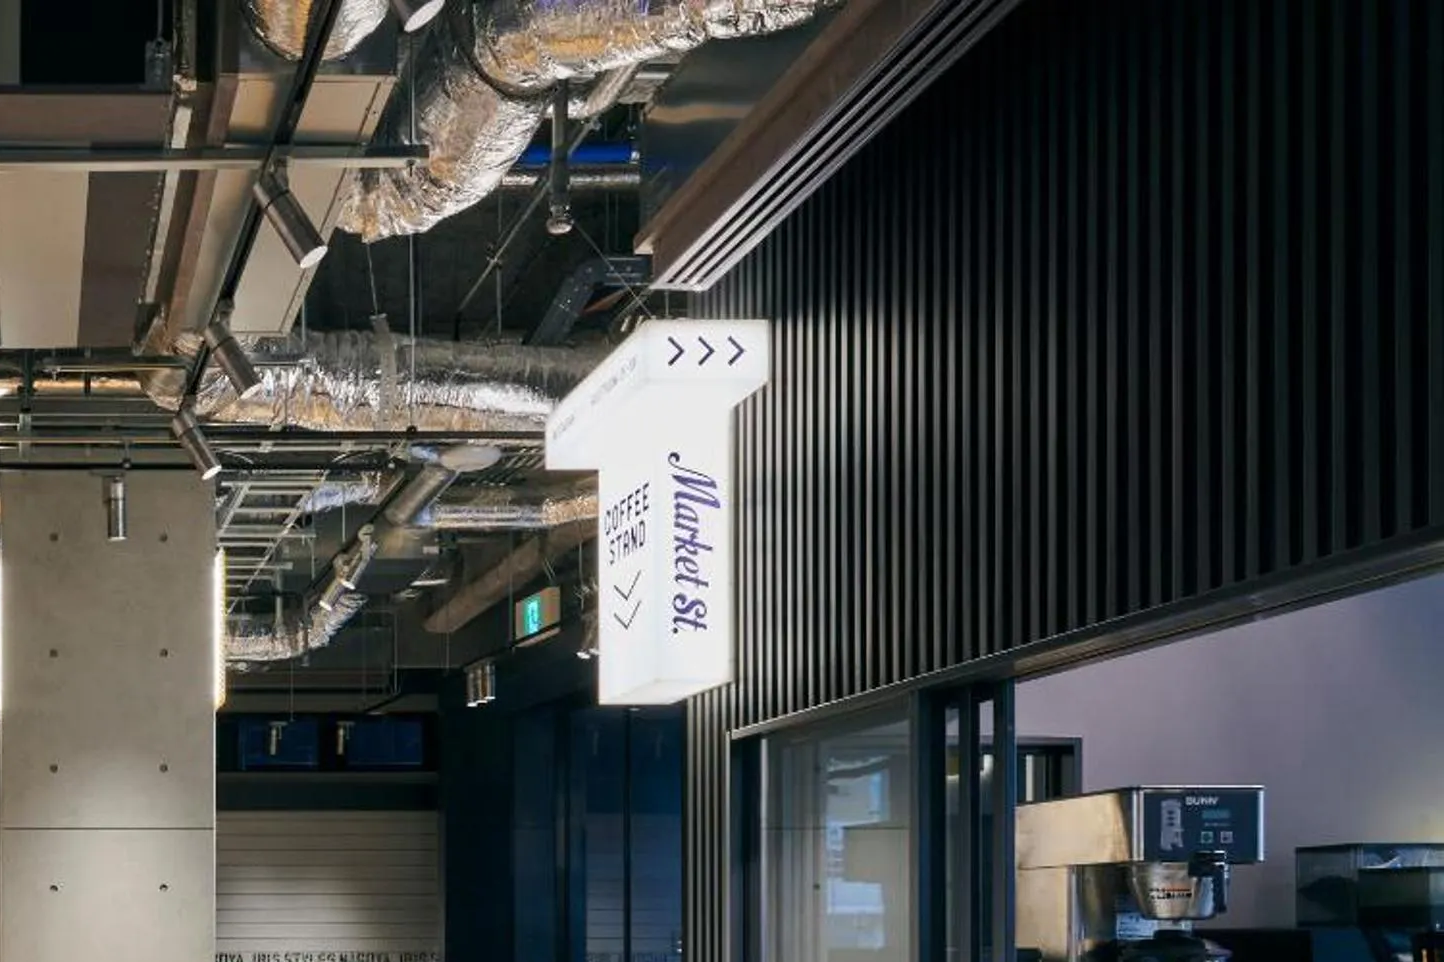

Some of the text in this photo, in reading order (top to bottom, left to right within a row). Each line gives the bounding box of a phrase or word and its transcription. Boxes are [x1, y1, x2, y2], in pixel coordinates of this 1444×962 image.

[604, 482, 649, 536] COFFEE
[609, 519, 646, 566] STAND
[668, 452, 721, 635] Market St.
